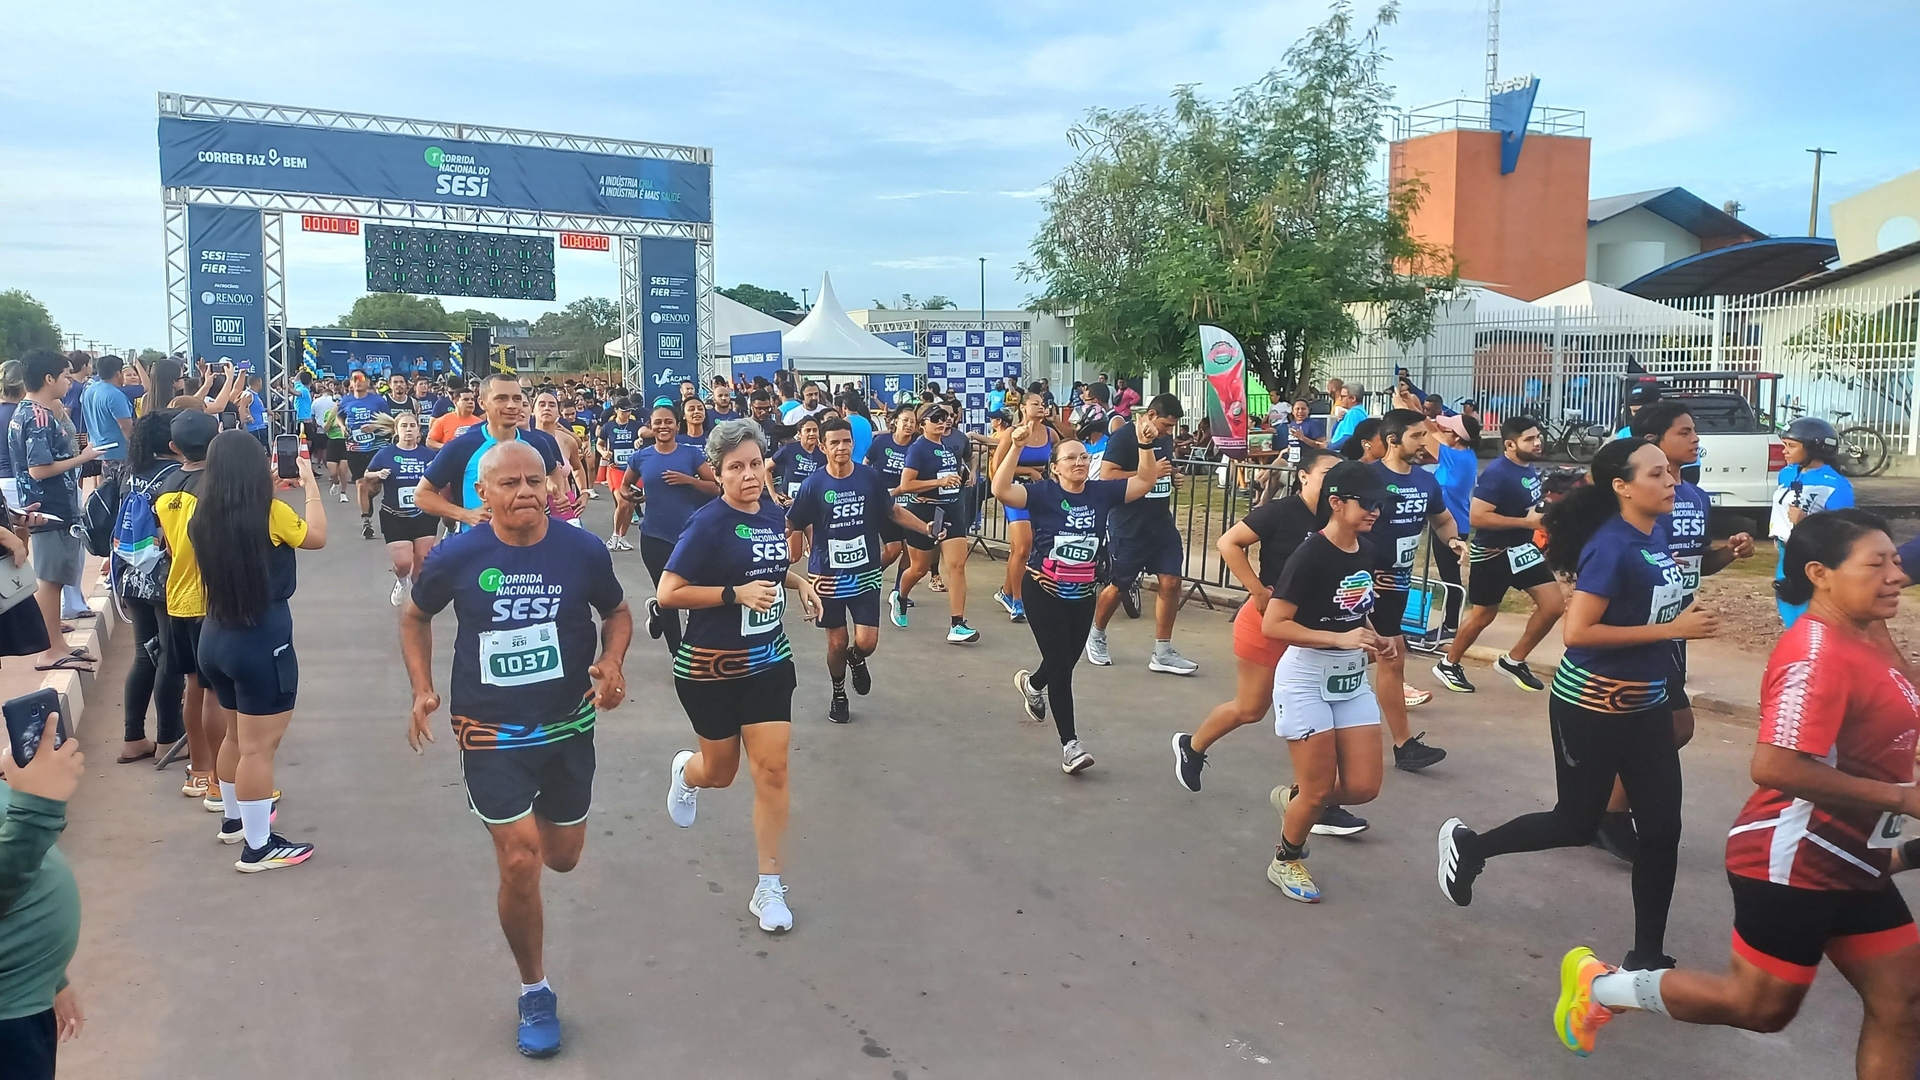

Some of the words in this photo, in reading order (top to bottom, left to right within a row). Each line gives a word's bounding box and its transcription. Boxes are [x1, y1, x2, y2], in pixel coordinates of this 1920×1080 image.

[198, 151, 244, 165] CORRER
[245, 154, 266, 166] FAZ
[268, 148, 278, 160] O
[282, 156, 307, 169] BEM
[440, 153, 475, 165] CORRIDA
[438, 163, 477, 175] NACIONAL
[478, 166, 490, 176] DO
[599, 175, 605, 185] A
[605, 175, 638, 188] INDÚSTRIA
[599, 186, 605, 196] A
[605, 186, 638, 199] INDÚSTRIA
[644, 190, 660, 201] MAIS
[216, 292, 254, 304] RENOVO
[661, 313, 690, 322] RENOVO
[215, 319, 241, 333] BODY
[215, 335, 227, 343] FOR
[228, 335, 242, 343] SURE
[660, 335, 680, 348] BODY
[886, 458, 905, 470] SES
[834, 490, 856, 499] CORRIDA
[897, 495, 909, 503] 001
[833, 498, 857, 506] NACIONAL
[838, 549, 864, 563] 1202
[1062, 546, 1089, 560] 1165
[498, 574, 543, 585] CORRIDA
[1662, 566, 1684, 586] SES
[1683, 574, 1696, 587] 79
[495, 585, 546, 596] NACIONAL
[548, 585, 562, 595] DO
[755, 604, 780, 623] 1051
[497, 649, 550, 674] 1037
